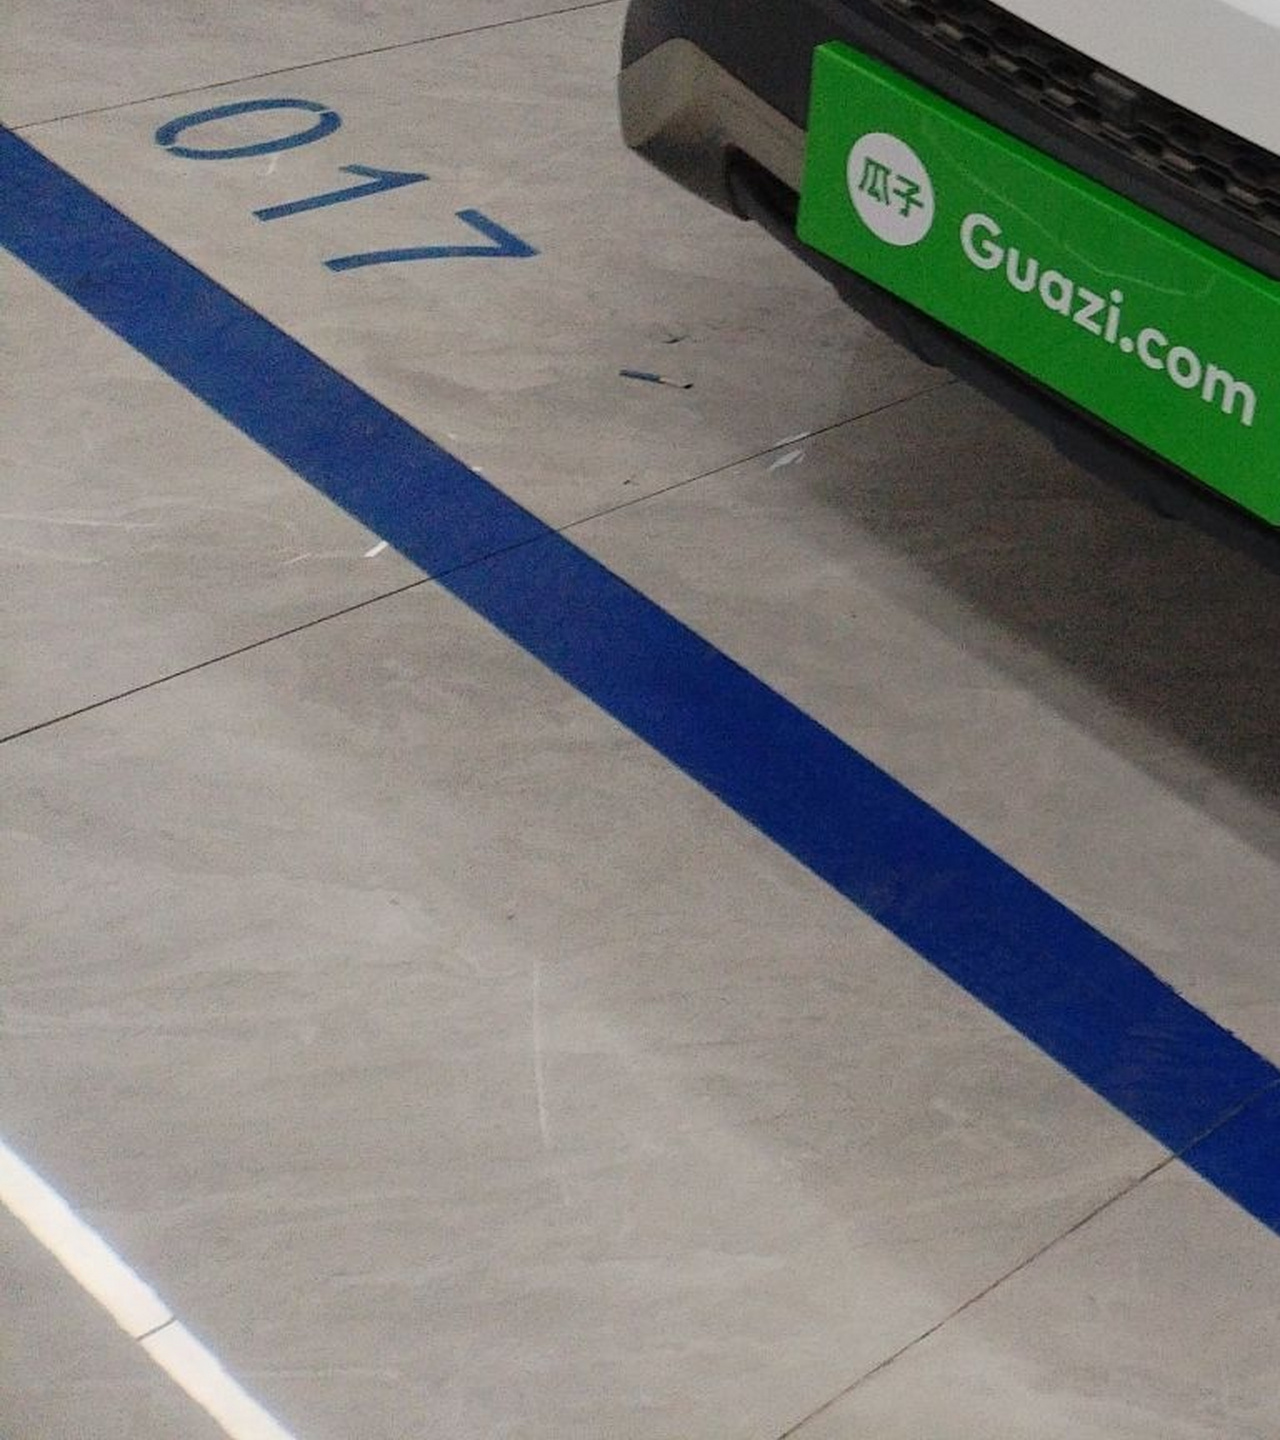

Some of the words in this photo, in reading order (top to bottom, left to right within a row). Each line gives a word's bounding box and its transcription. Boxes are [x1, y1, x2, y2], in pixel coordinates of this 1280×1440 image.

[154, 97, 540, 273] 017
[857, 156, 925, 218] 瓜子
[959, 212, 1259, 427] Guazi.com
